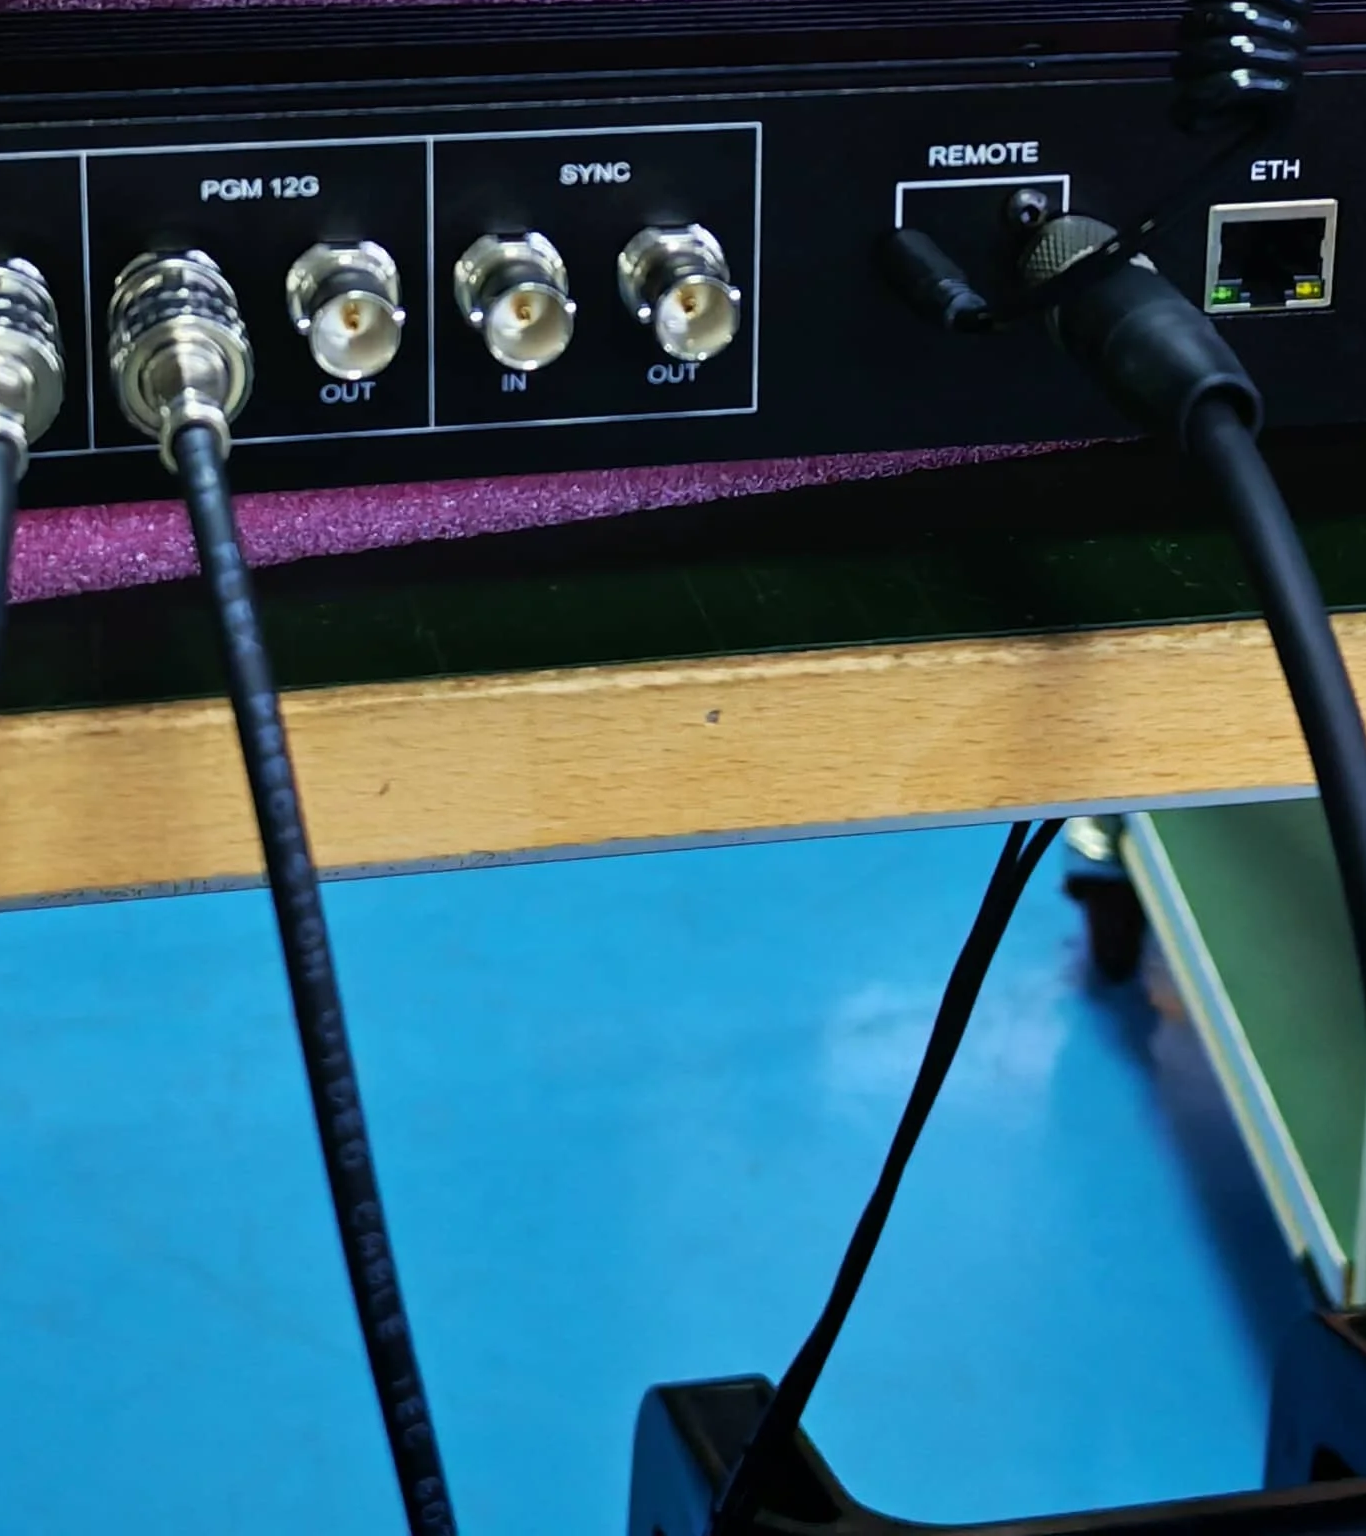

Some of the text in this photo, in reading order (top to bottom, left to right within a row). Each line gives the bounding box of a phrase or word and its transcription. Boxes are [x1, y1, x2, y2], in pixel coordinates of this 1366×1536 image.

[928, 141, 1039, 167] REMOTE
[560, 161, 631, 185] SYNC
[1250, 159, 1300, 181] ETH
[201, 175, 320, 201] PGM 12G
[502, 372, 527, 392] IN
[647, 362, 701, 385] OUT
[320, 378, 376, 403] OUT
